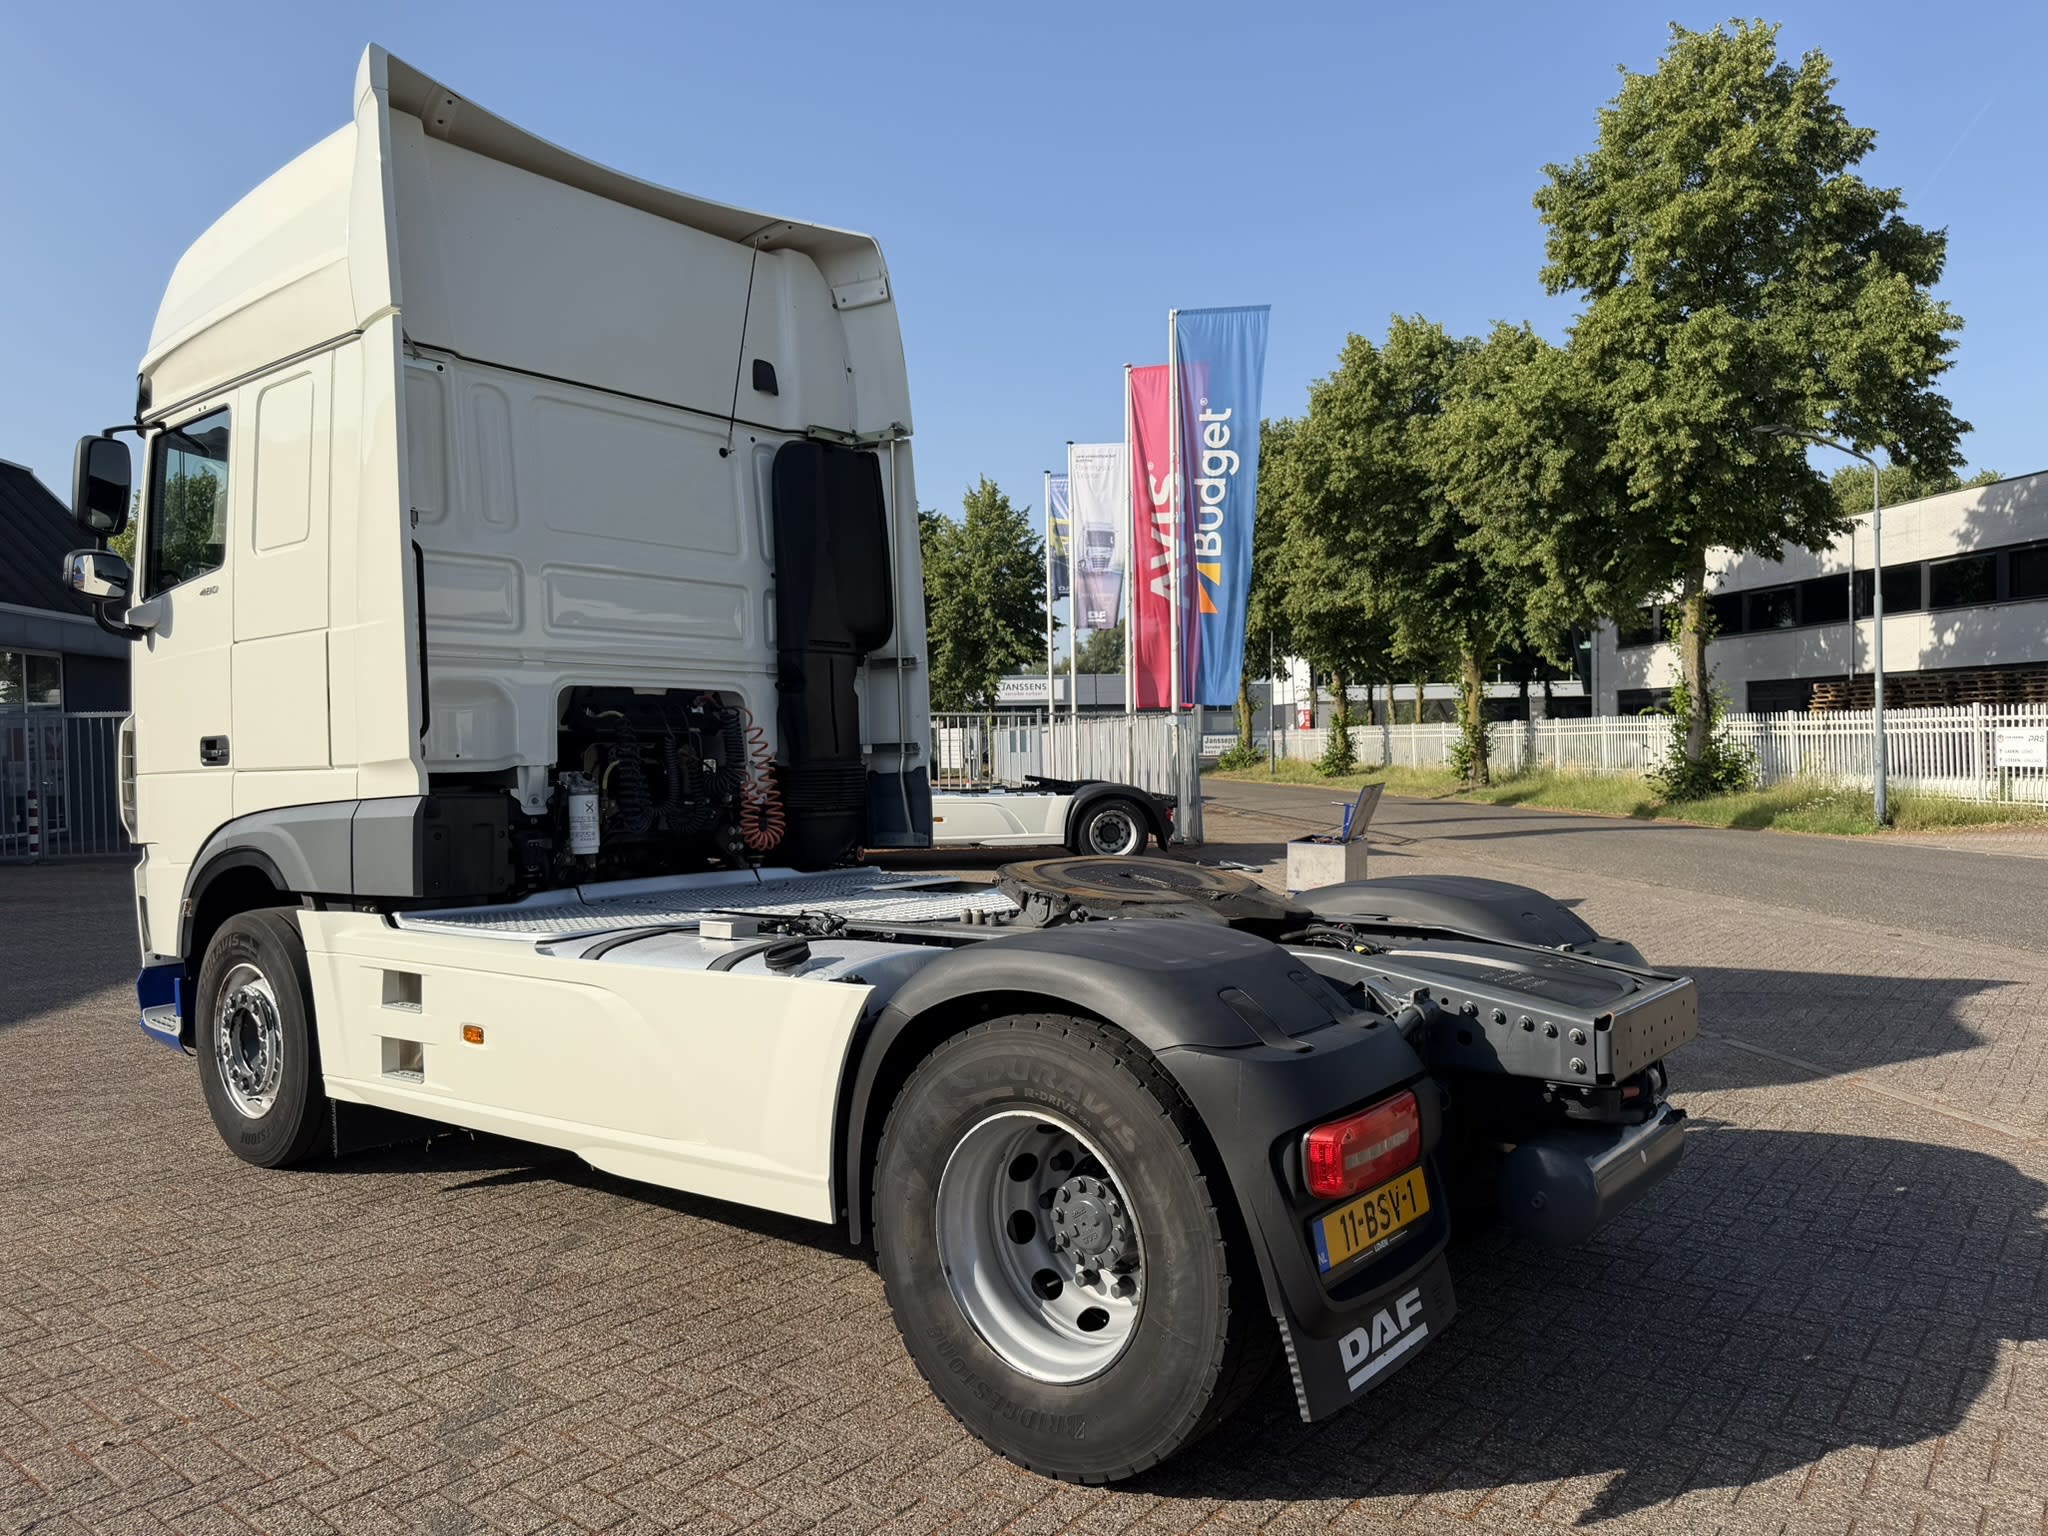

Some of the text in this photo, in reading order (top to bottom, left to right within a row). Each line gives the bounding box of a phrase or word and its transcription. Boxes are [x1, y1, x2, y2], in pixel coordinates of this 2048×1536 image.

[1194, 407, 1240, 557] Budget
[1149, 472, 1187, 608] AVIS
[1001, 682, 1047, 692] JANSSENS
[982, 1055, 1137, 1153] DURAVIS
[1023, 1087, 1078, 1116] R-DRIVE
[1339, 1178, 1418, 1253] 11-BSV-1
[1338, 1287, 1424, 1373] DAF
[926, 1326, 1087, 1441] BRIDGESTONE
